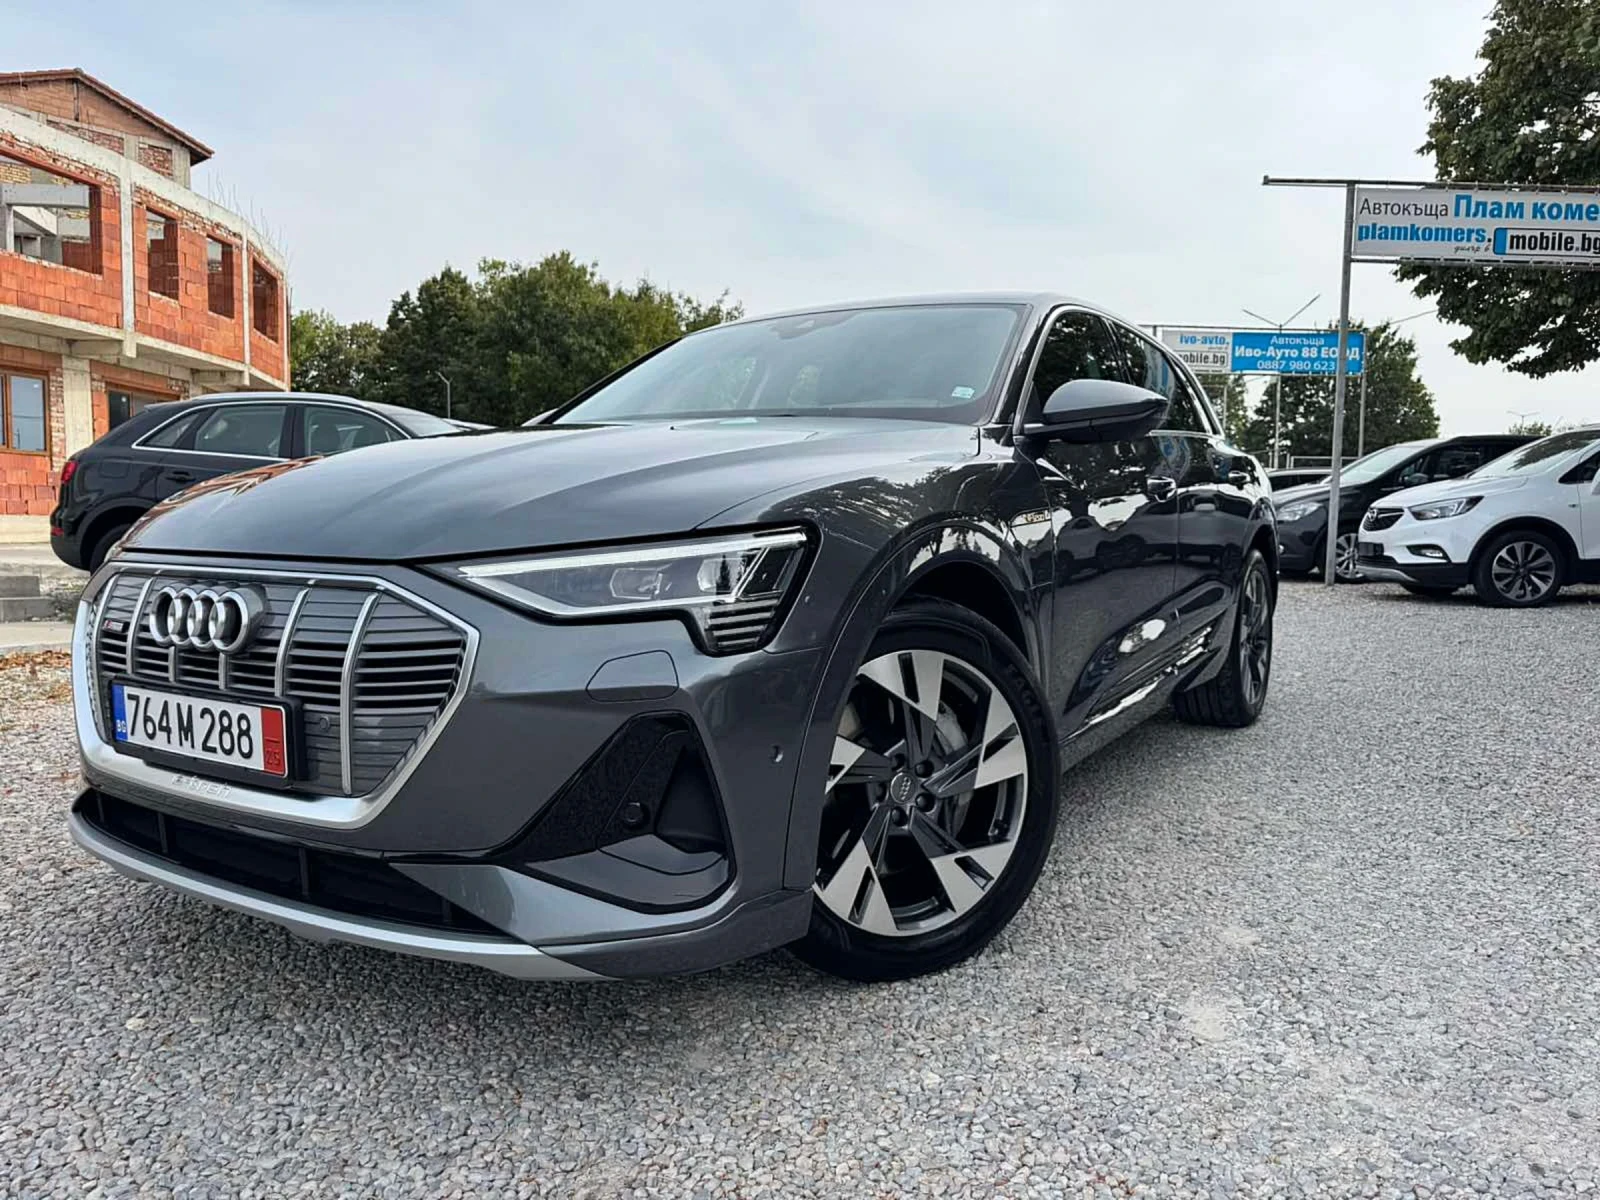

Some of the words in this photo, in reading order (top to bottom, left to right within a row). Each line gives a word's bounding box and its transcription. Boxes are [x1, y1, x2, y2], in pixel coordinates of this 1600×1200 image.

[1359, 198, 1449, 219] Автокъща
[1454, 194, 1525, 219] Плам
[1531, 202, 1600, 221] коме
[1509, 231, 1600, 255] mobile.bg
[1270, 335, 1325, 347] Автокъща
[1235, 346, 1299, 360] Иво-Ауто
[1301, 347, 1318, 358] 88
[1320, 347, 1360, 360] ЕОД
[1256, 360, 1286, 370] 0887
[1289, 360, 1311, 371] 980
[1313, 361, 1336, 371] 623
